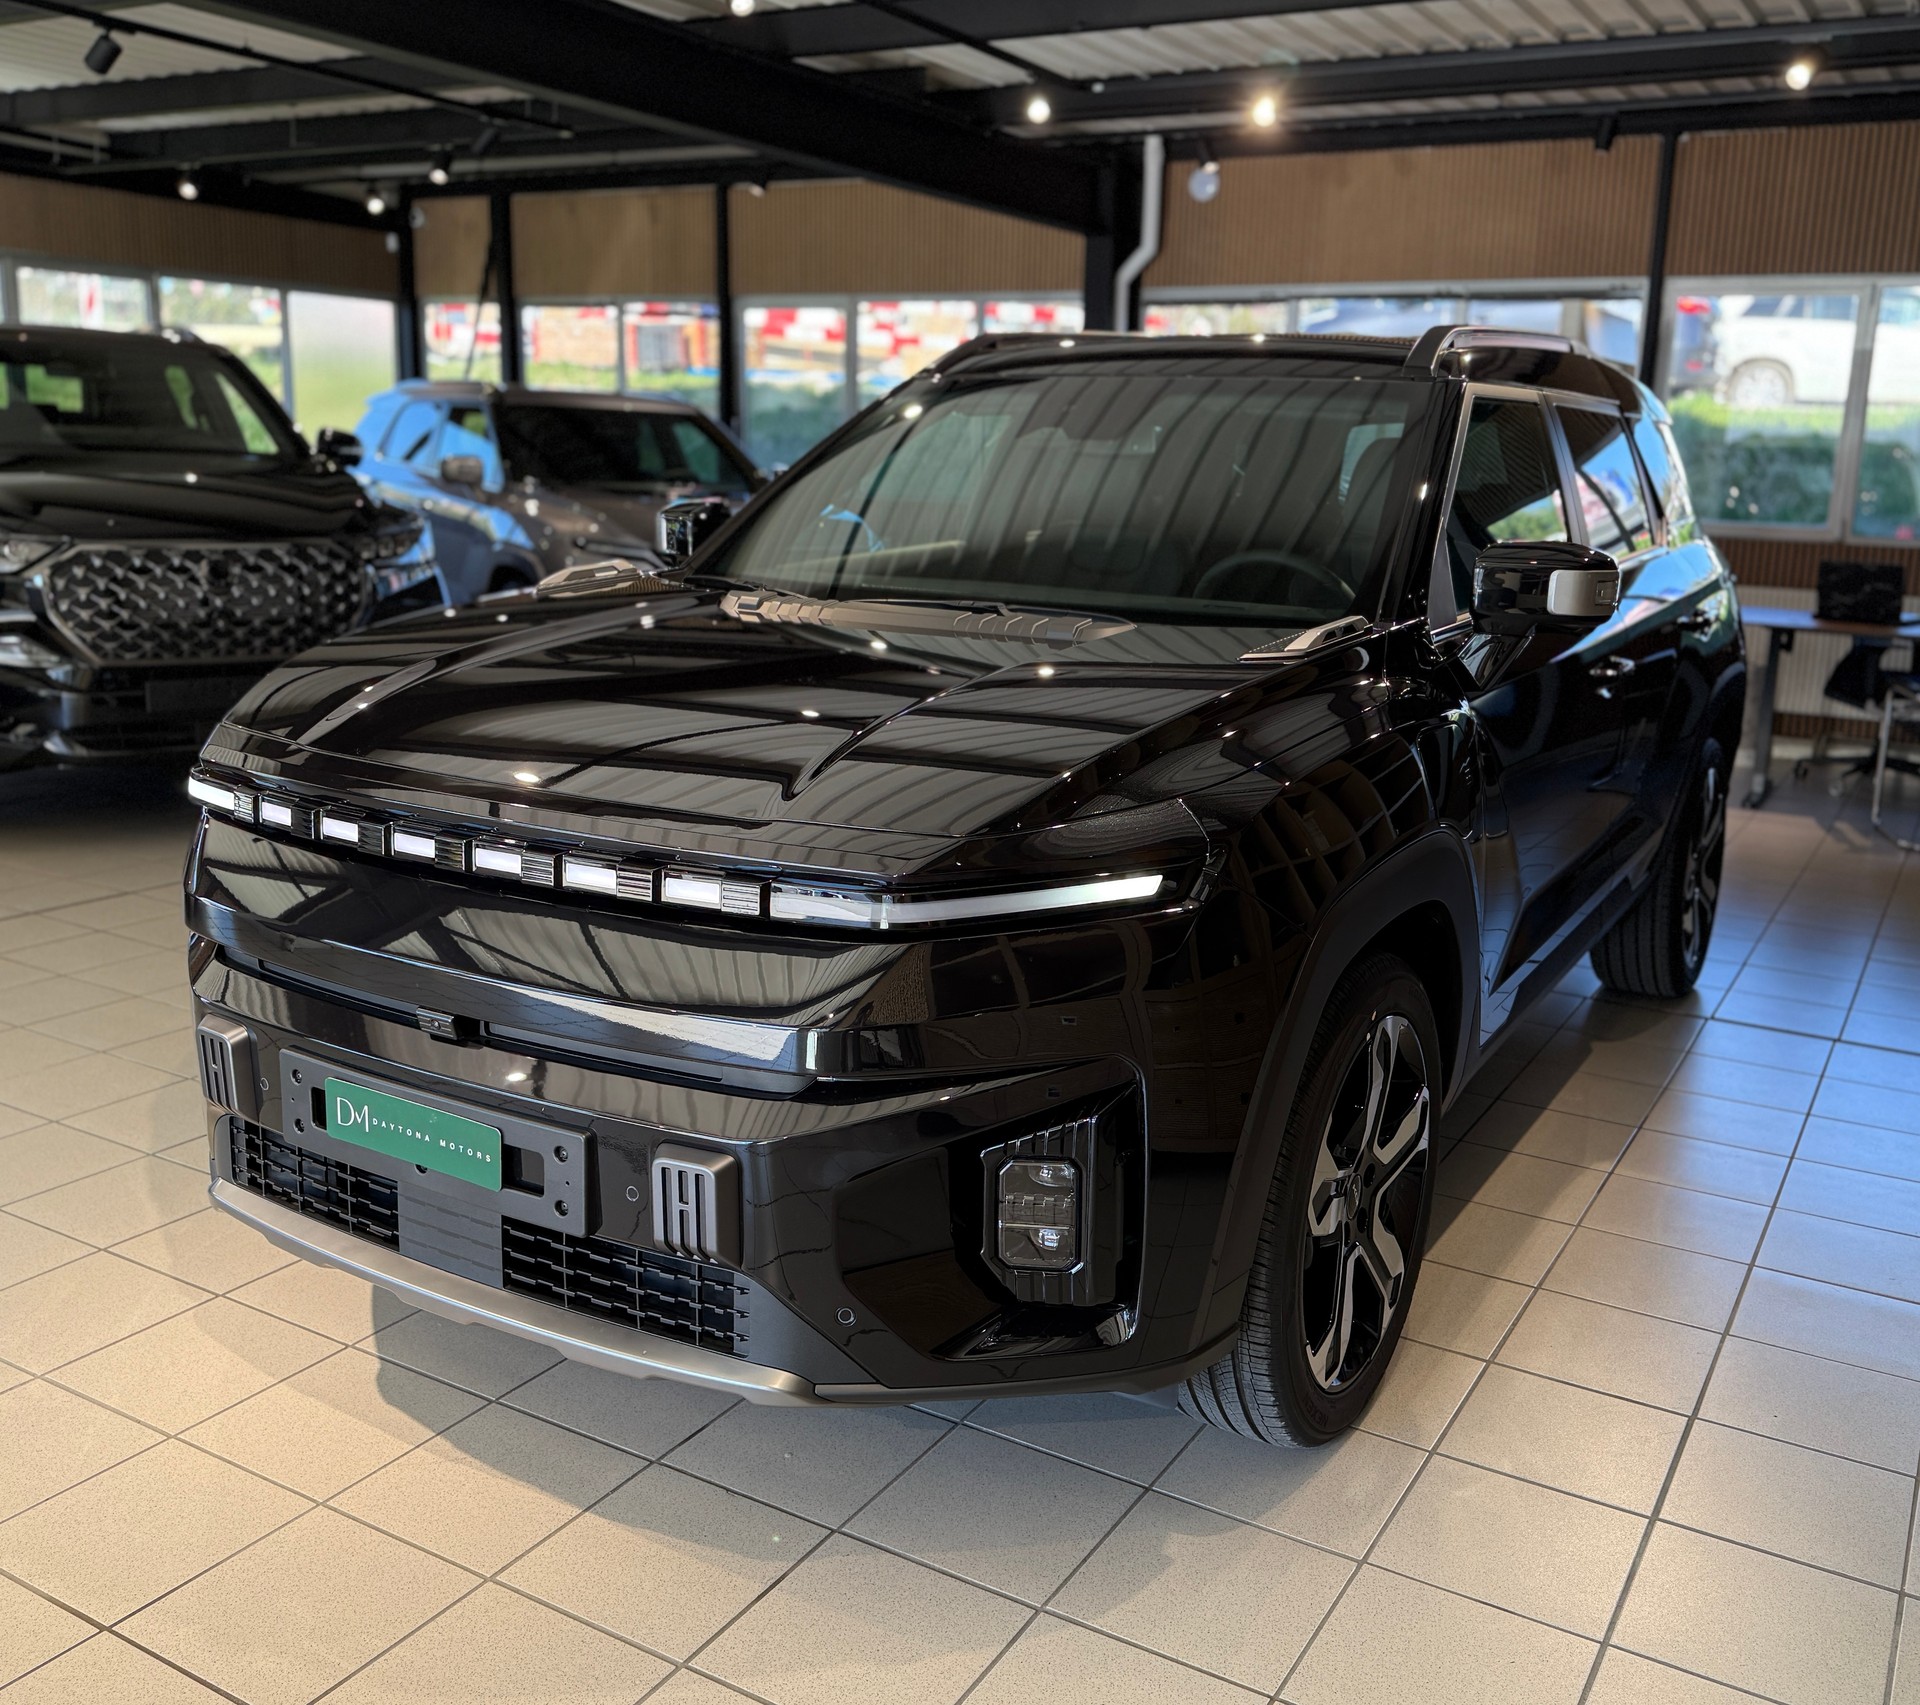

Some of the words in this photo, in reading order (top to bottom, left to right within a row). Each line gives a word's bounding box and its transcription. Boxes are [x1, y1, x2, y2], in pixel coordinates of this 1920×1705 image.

[336, 1096, 369, 1133] DM
[372, 1117, 430, 1142] DAYTONA
[439, 1139, 491, 1162] MOTORS
